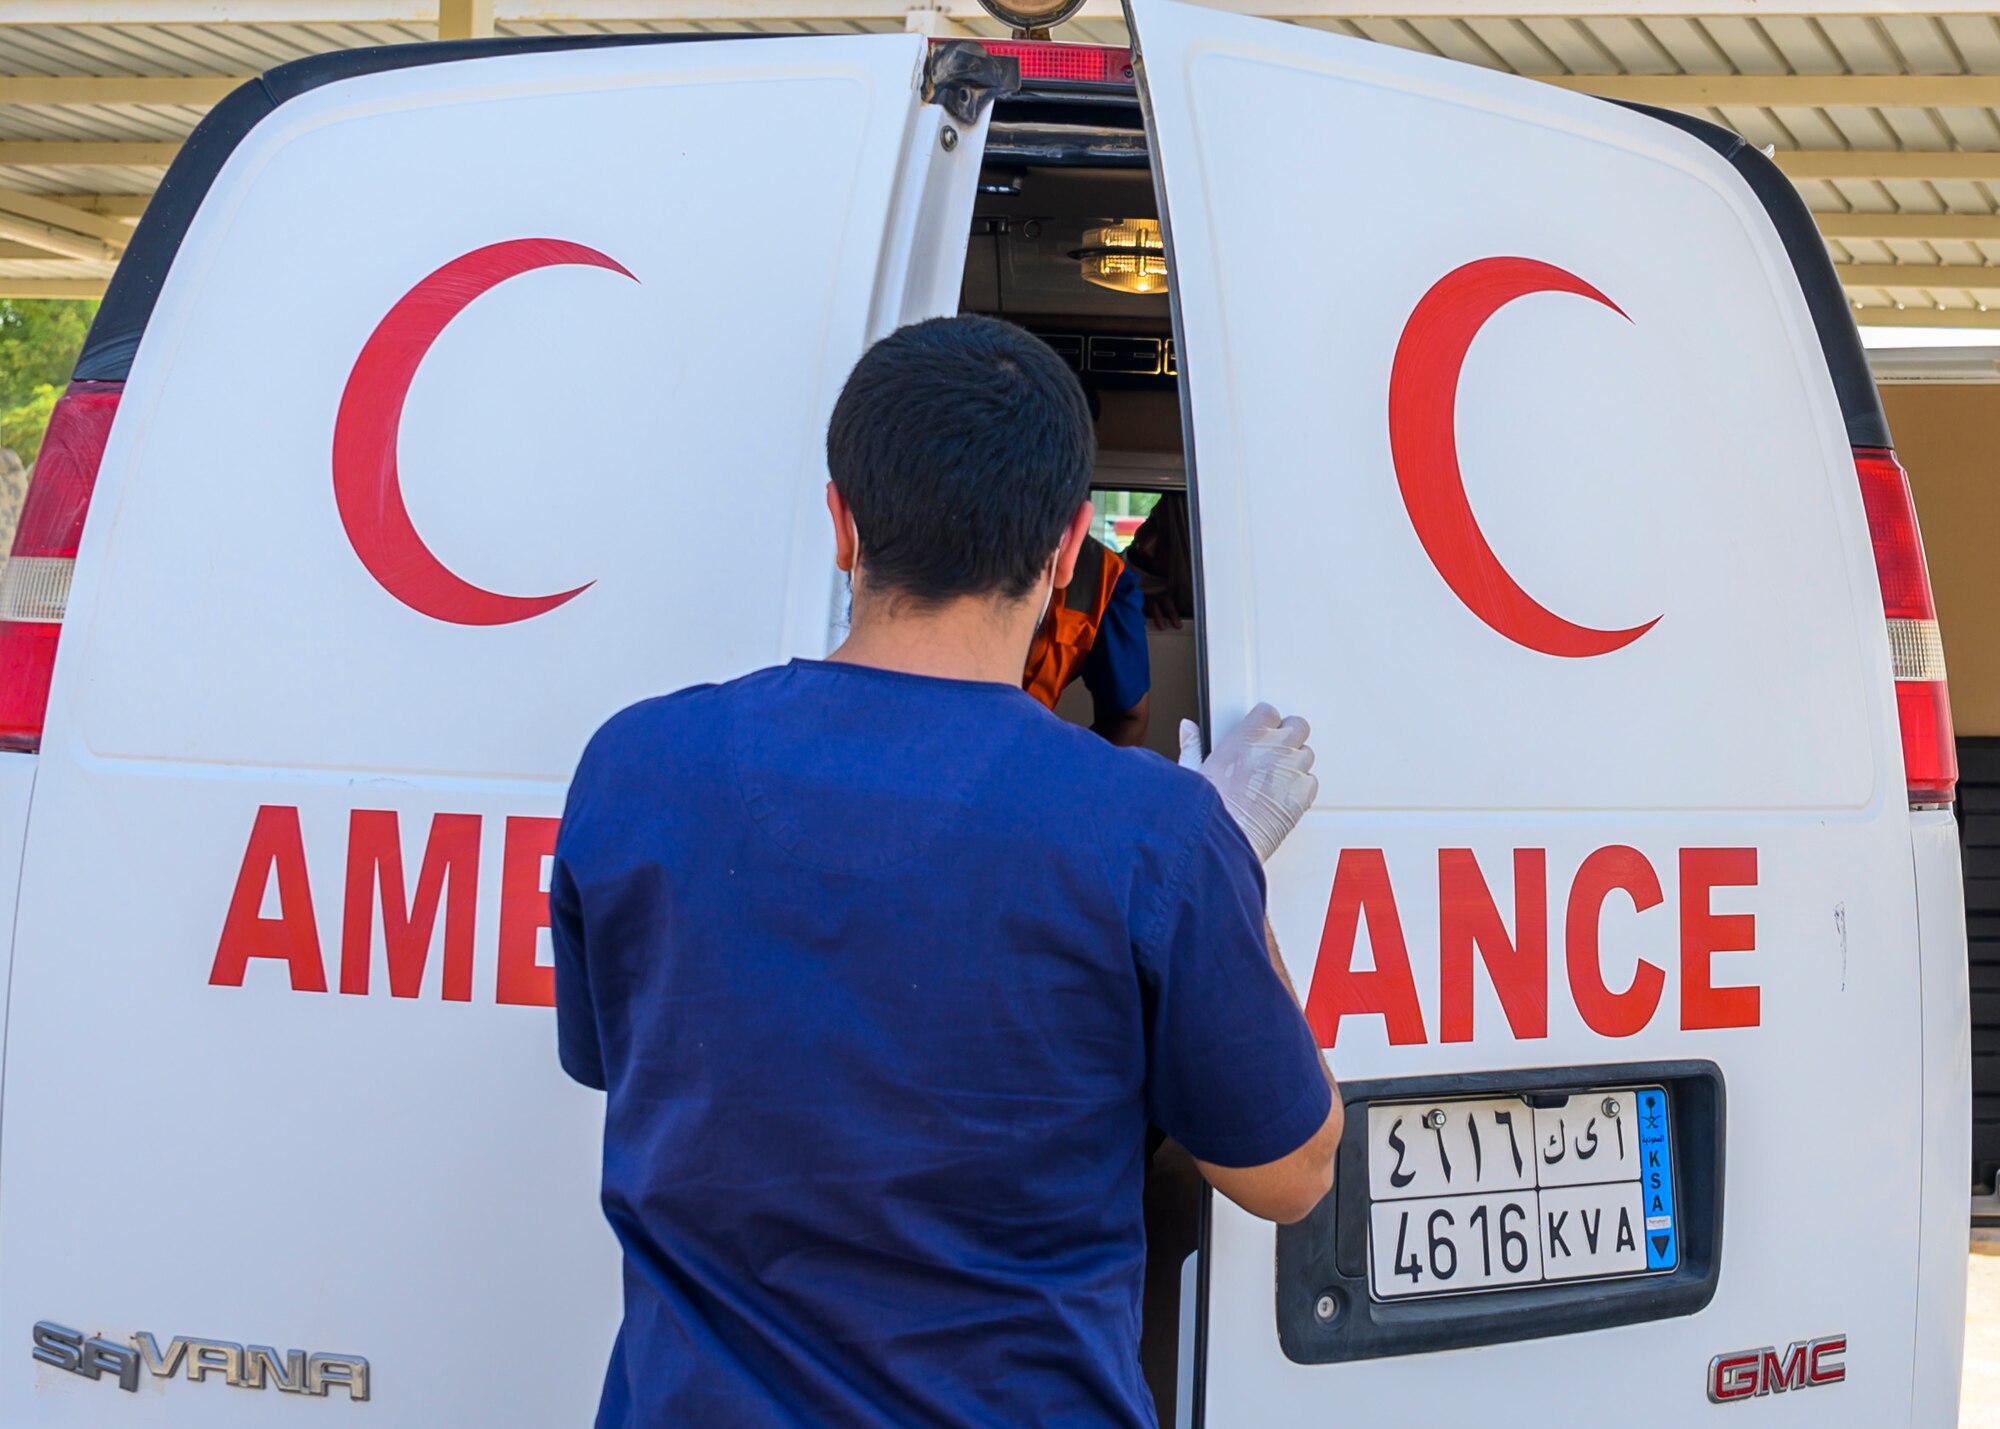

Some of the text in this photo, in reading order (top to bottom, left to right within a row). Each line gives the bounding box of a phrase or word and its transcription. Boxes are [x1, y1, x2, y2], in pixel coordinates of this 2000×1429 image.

[1304, 844, 1761, 1049] ANCE
[1649, 1150, 1663, 1212] KSA
[1394, 1203, 1528, 1283] 4616
[1548, 1206, 1636, 1258] KVA
[32, 1320, 371, 1402] SAVANA
[1706, 1333, 1847, 1404] GMC
